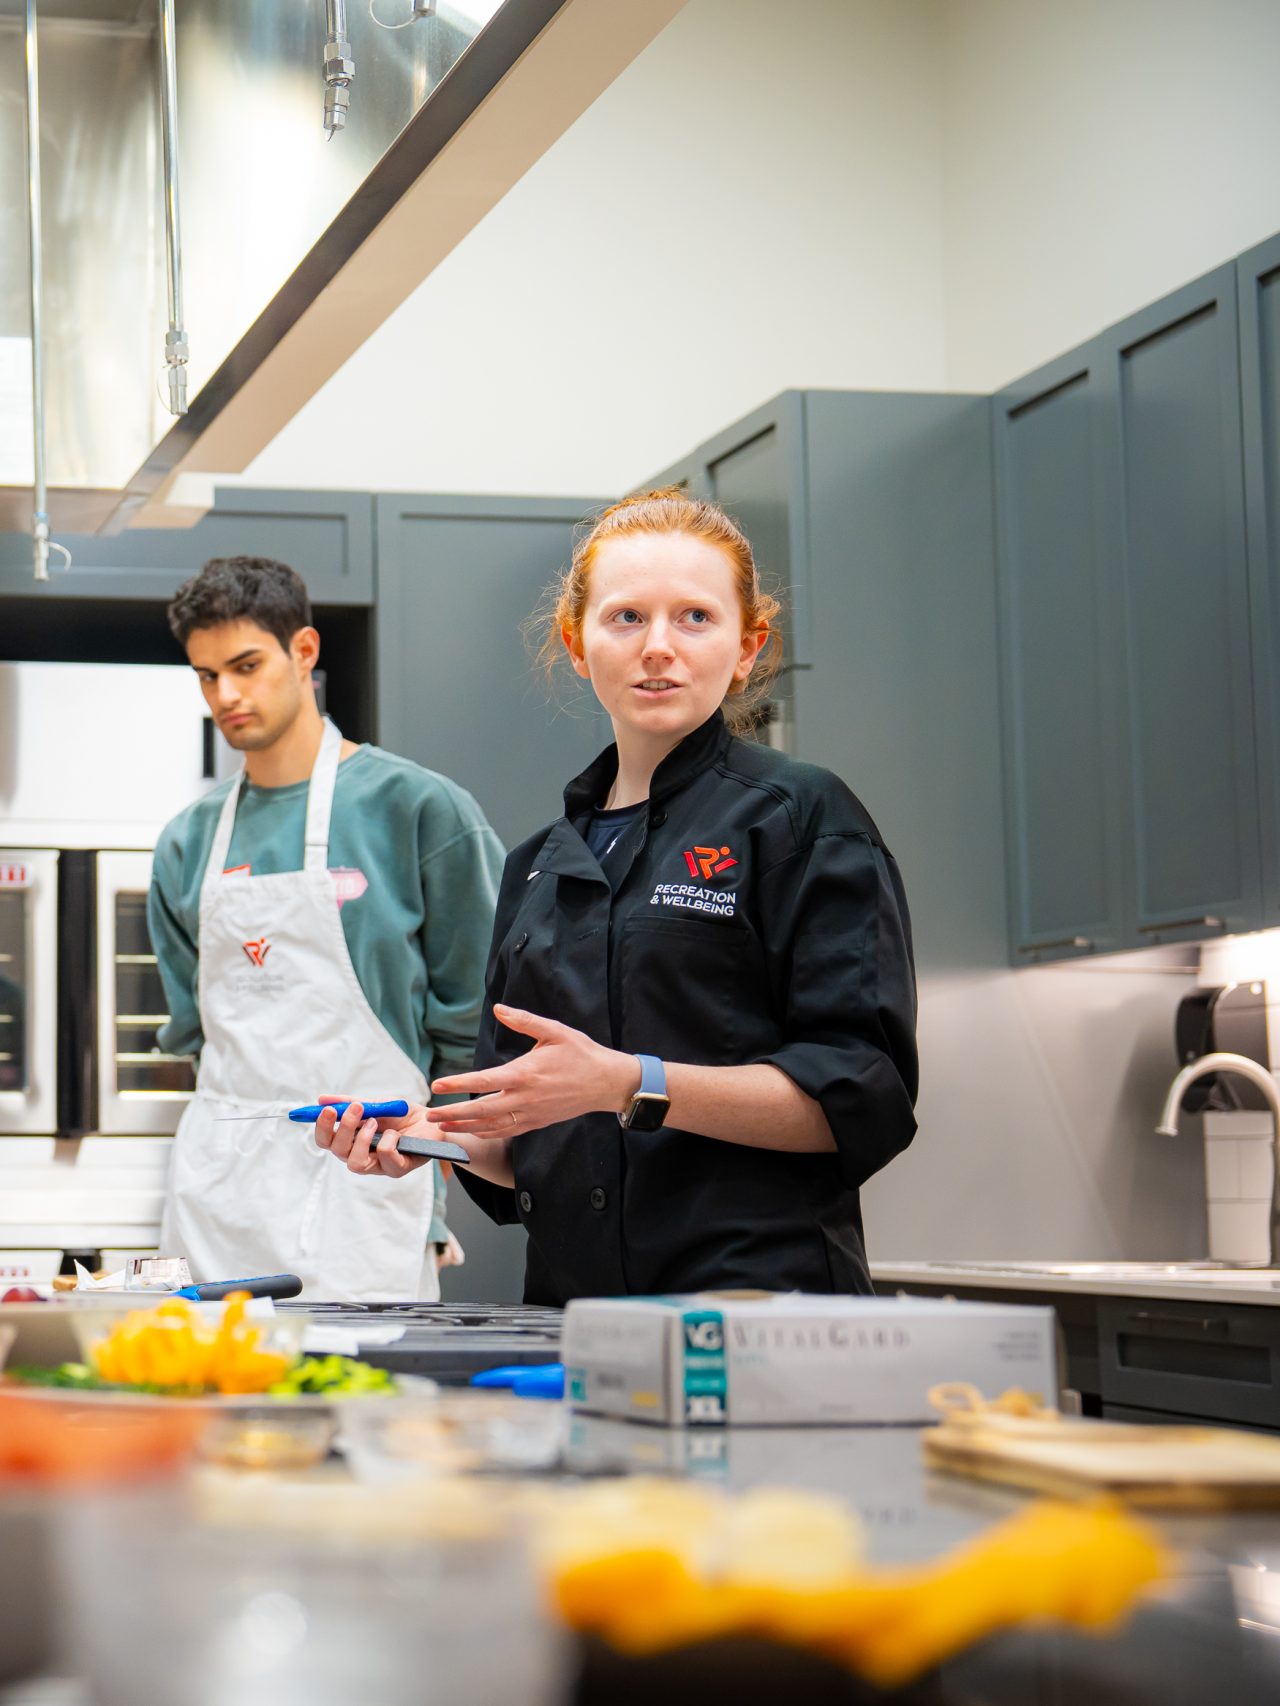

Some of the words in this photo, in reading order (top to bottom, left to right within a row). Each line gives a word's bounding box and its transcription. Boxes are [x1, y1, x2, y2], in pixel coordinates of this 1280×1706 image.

[654, 884, 737, 905] RECREATION
[649, 895, 660, 905] &
[662, 895, 735, 917] WELLBEING
[687, 1321, 722, 1350] VG
